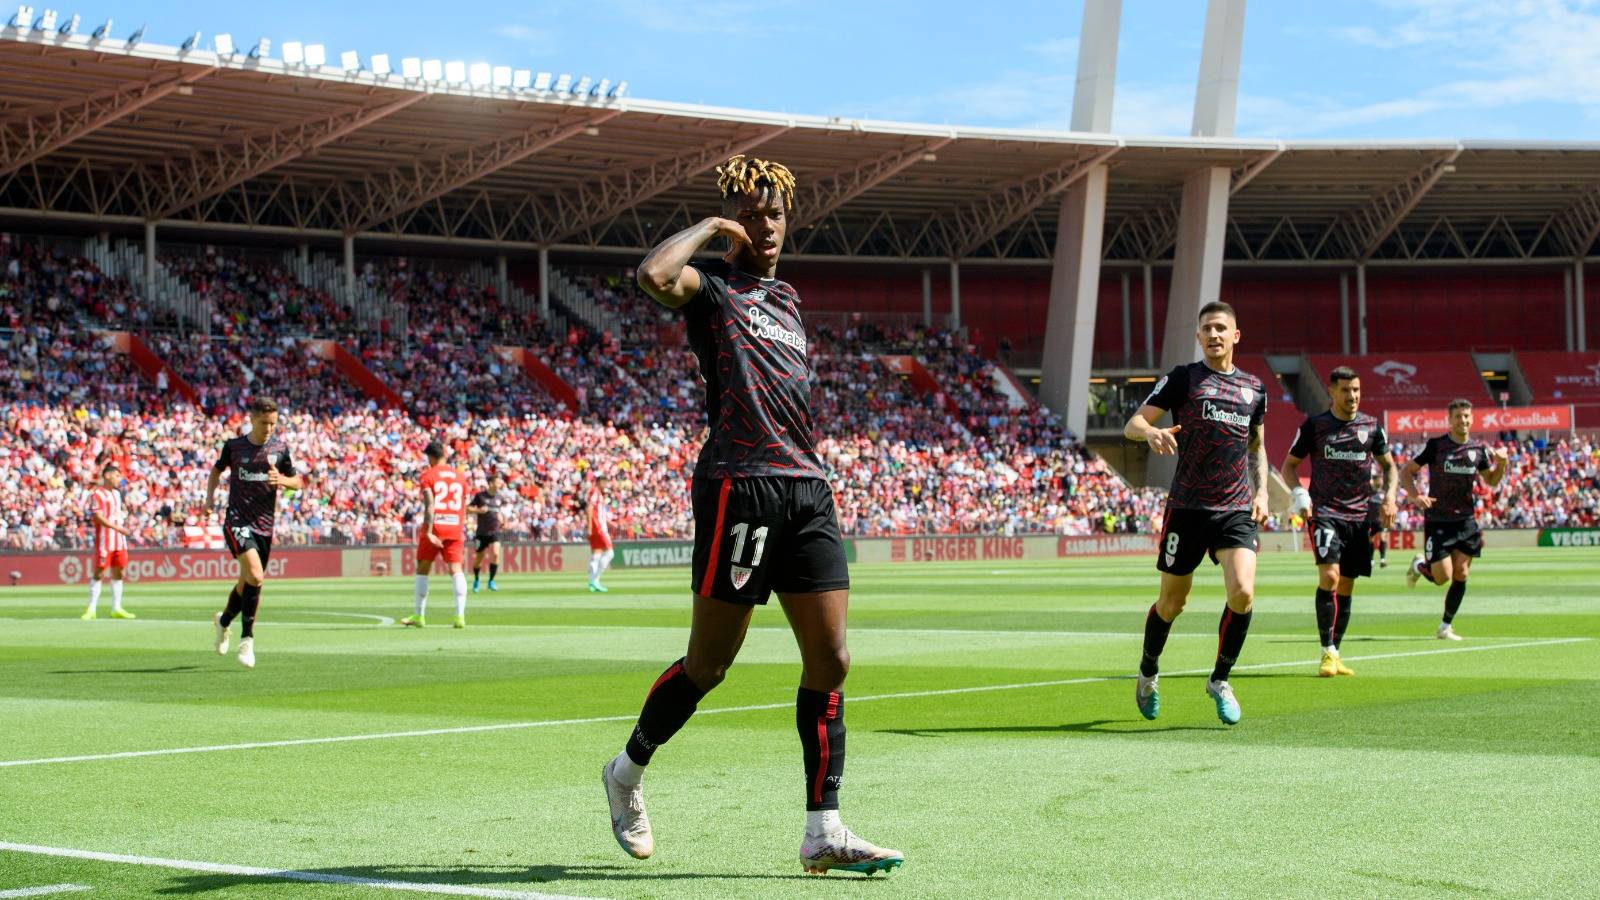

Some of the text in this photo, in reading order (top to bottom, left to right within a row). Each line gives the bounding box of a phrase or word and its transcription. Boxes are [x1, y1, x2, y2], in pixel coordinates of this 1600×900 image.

[1413, 414, 1450, 430] Caixa
[1501, 411, 1559, 427] CaixaBank
[434, 481, 463, 511] 23
[730, 522, 769, 567] 11
[912, 537, 977, 561] BURGER
[983, 536, 1024, 559] KING
[1166, 532, 1180, 556] 8
[1314, 528, 1335, 548] 17
[1426, 536, 1433, 550] 6
[1551, 531, 1600, 546] VEGET
[180, 554, 288, 578] Santaer
[503, 544, 563, 572] KING
[623, 547, 693, 566] VEGETALE
